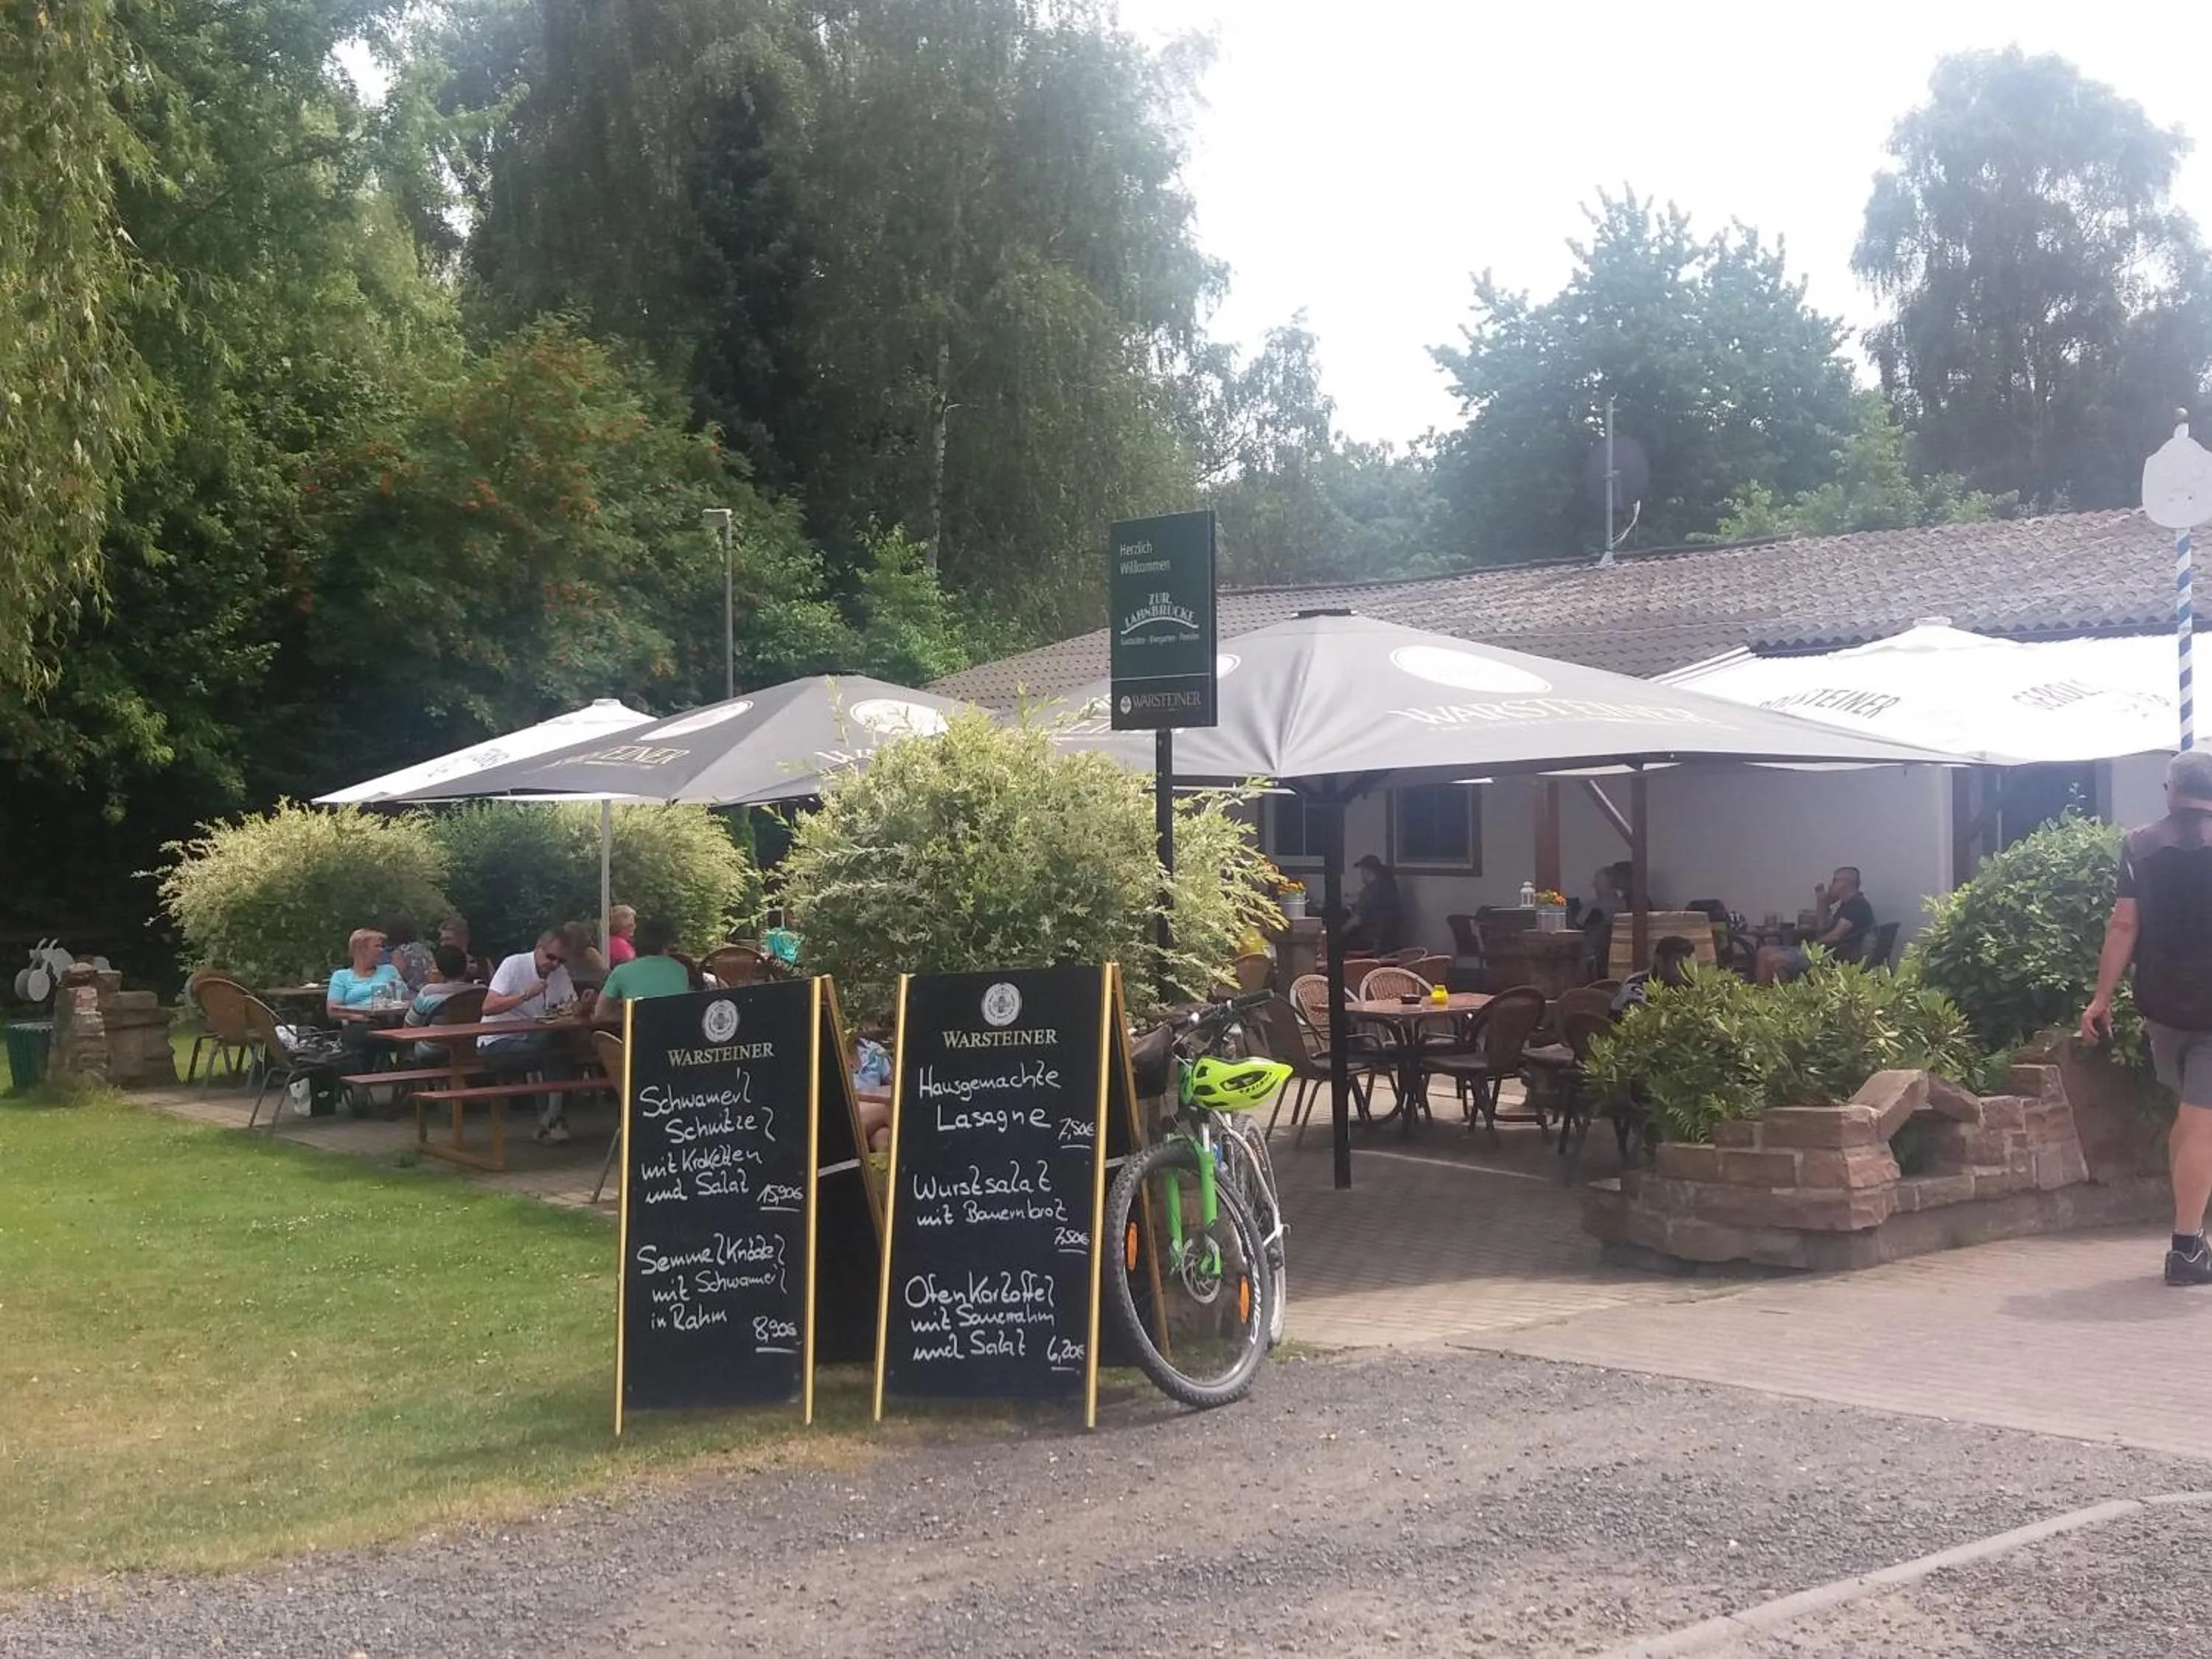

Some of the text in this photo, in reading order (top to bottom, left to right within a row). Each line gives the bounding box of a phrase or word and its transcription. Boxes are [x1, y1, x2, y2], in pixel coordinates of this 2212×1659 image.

[1120, 540, 1152, 557] Herzlich
[1120, 560, 1171, 575] Willkommen
[1148, 592, 1173, 605] ZUR
[1132, 691, 1202, 709] WARSTEINER
[943, 1029, 1059, 1049] WARSTEINER
[668, 1042, 775, 1067] WARSTEINER
[919, 1060, 1062, 1102] Hausgemachte
[936, 1104, 1052, 1133] Lasagne
[641, 1152, 678, 1180] mit
[913, 1160, 1053, 1200] Wurstsalat
[645, 1178, 688, 1204] und
[695, 1168, 750, 1196] Salat
[917, 1198, 1068, 1226] mit Bauernbrot
[652, 1274, 691, 1303] mit
[650, 1312, 667, 1329] in
[669, 1302, 728, 1331] Rahm
[911, 1303, 1054, 1332] mit Sauerrahm
[913, 1333, 965, 1360] und
[970, 1329, 1026, 1356] Salat
